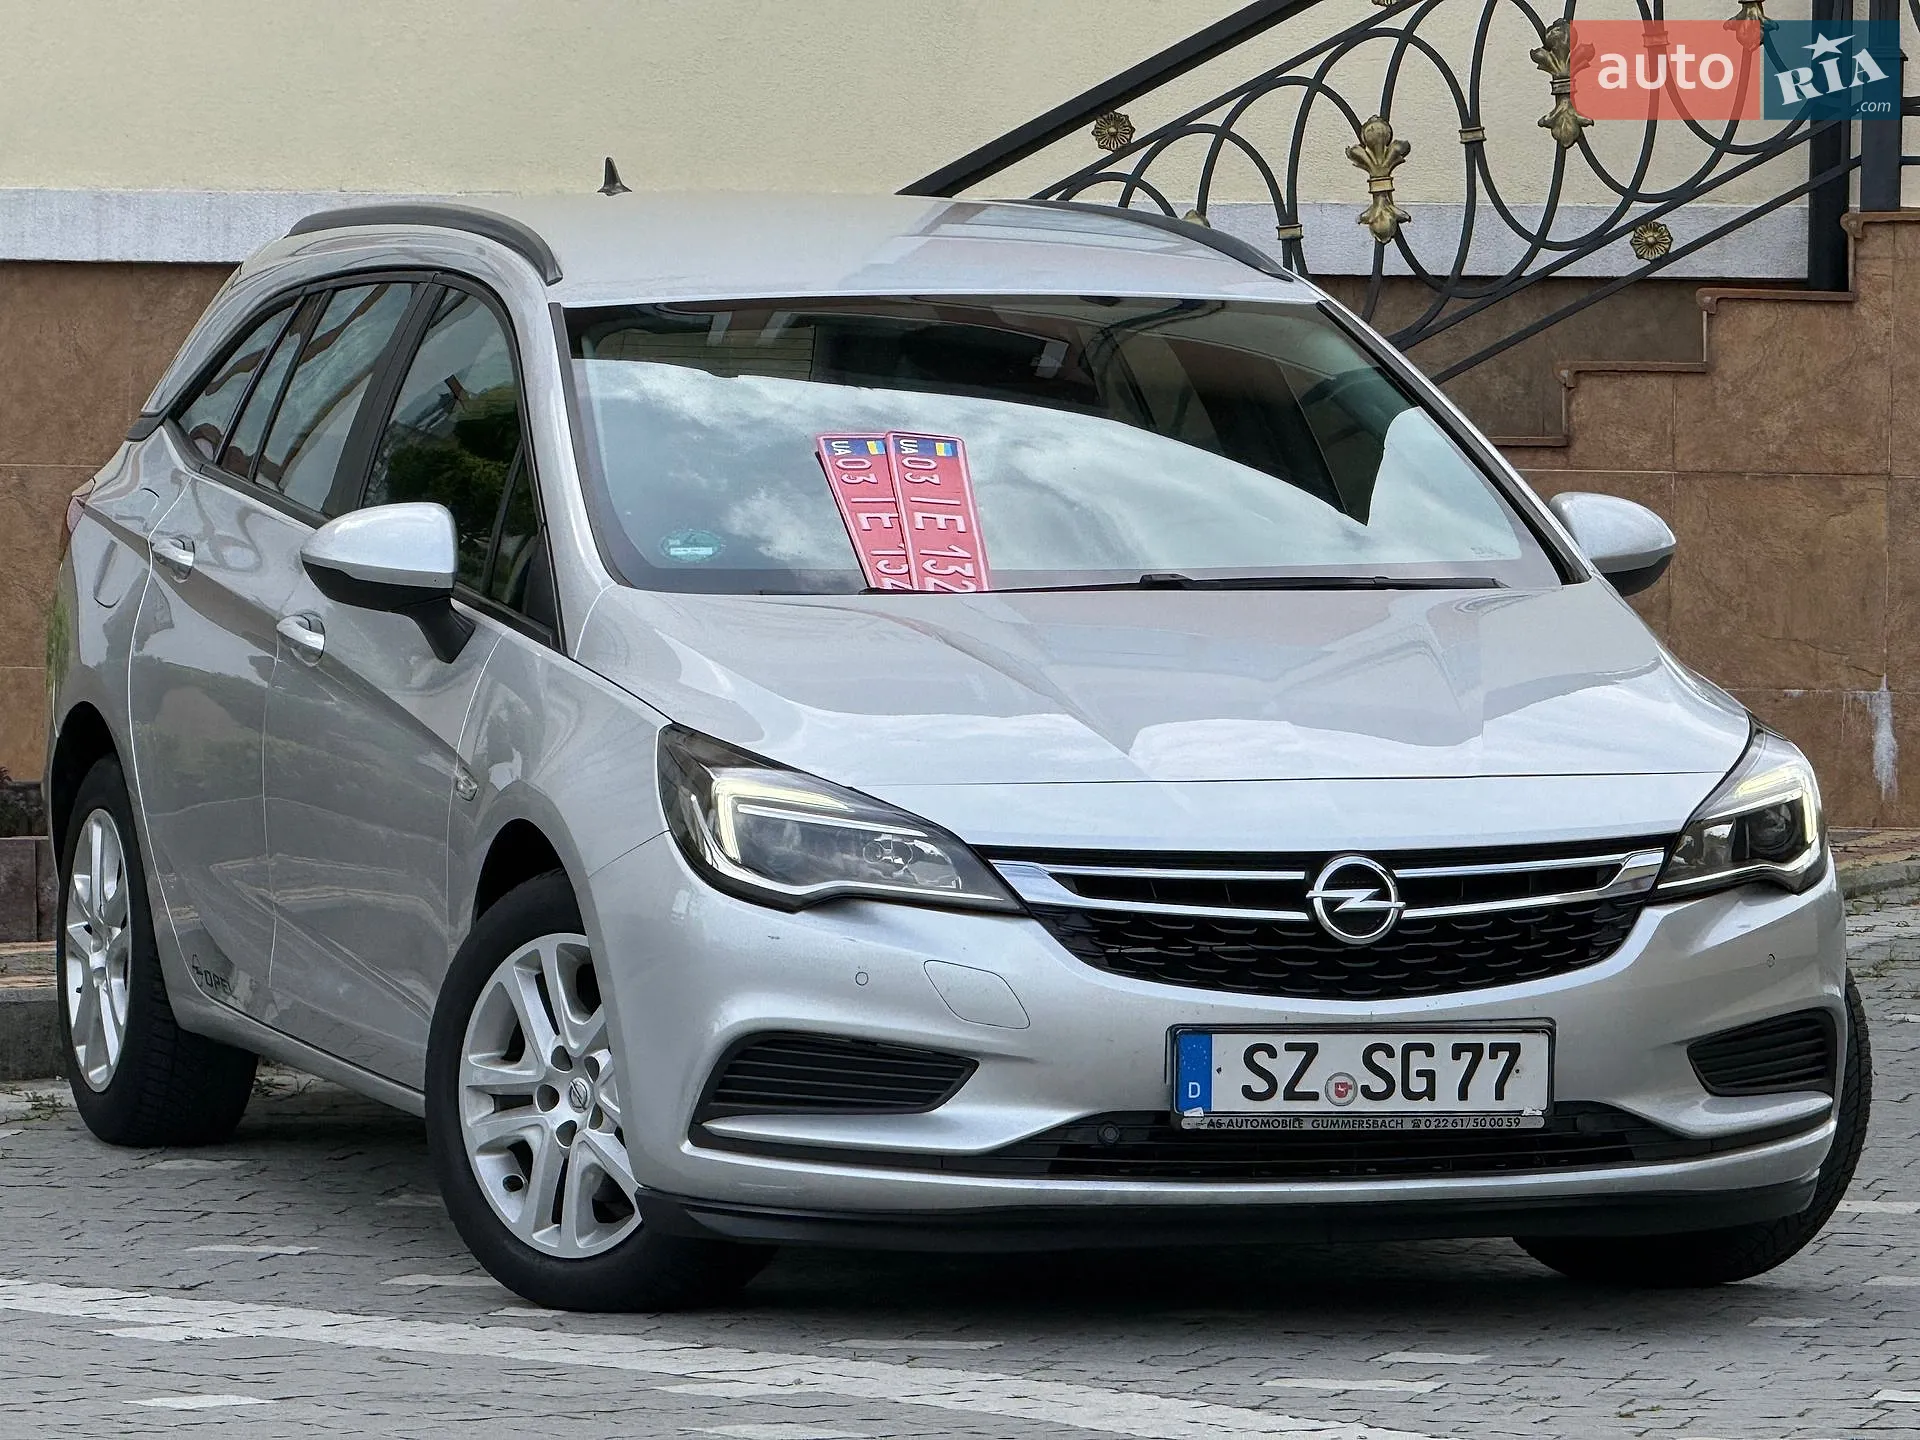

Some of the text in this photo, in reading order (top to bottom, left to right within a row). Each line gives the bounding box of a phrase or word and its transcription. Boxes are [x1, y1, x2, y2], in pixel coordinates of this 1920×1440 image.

[831, 440, 852, 456] UA
[899, 439, 919, 454] UA
[835, 458, 878, 485] 03
[901, 456, 941, 486] 03
[1241, 1042, 1521, 1102] SZ SG 77
[1187, 1082, 1201, 1099] D
[1311, 1118, 1404, 1130] GUMMERSBACH
